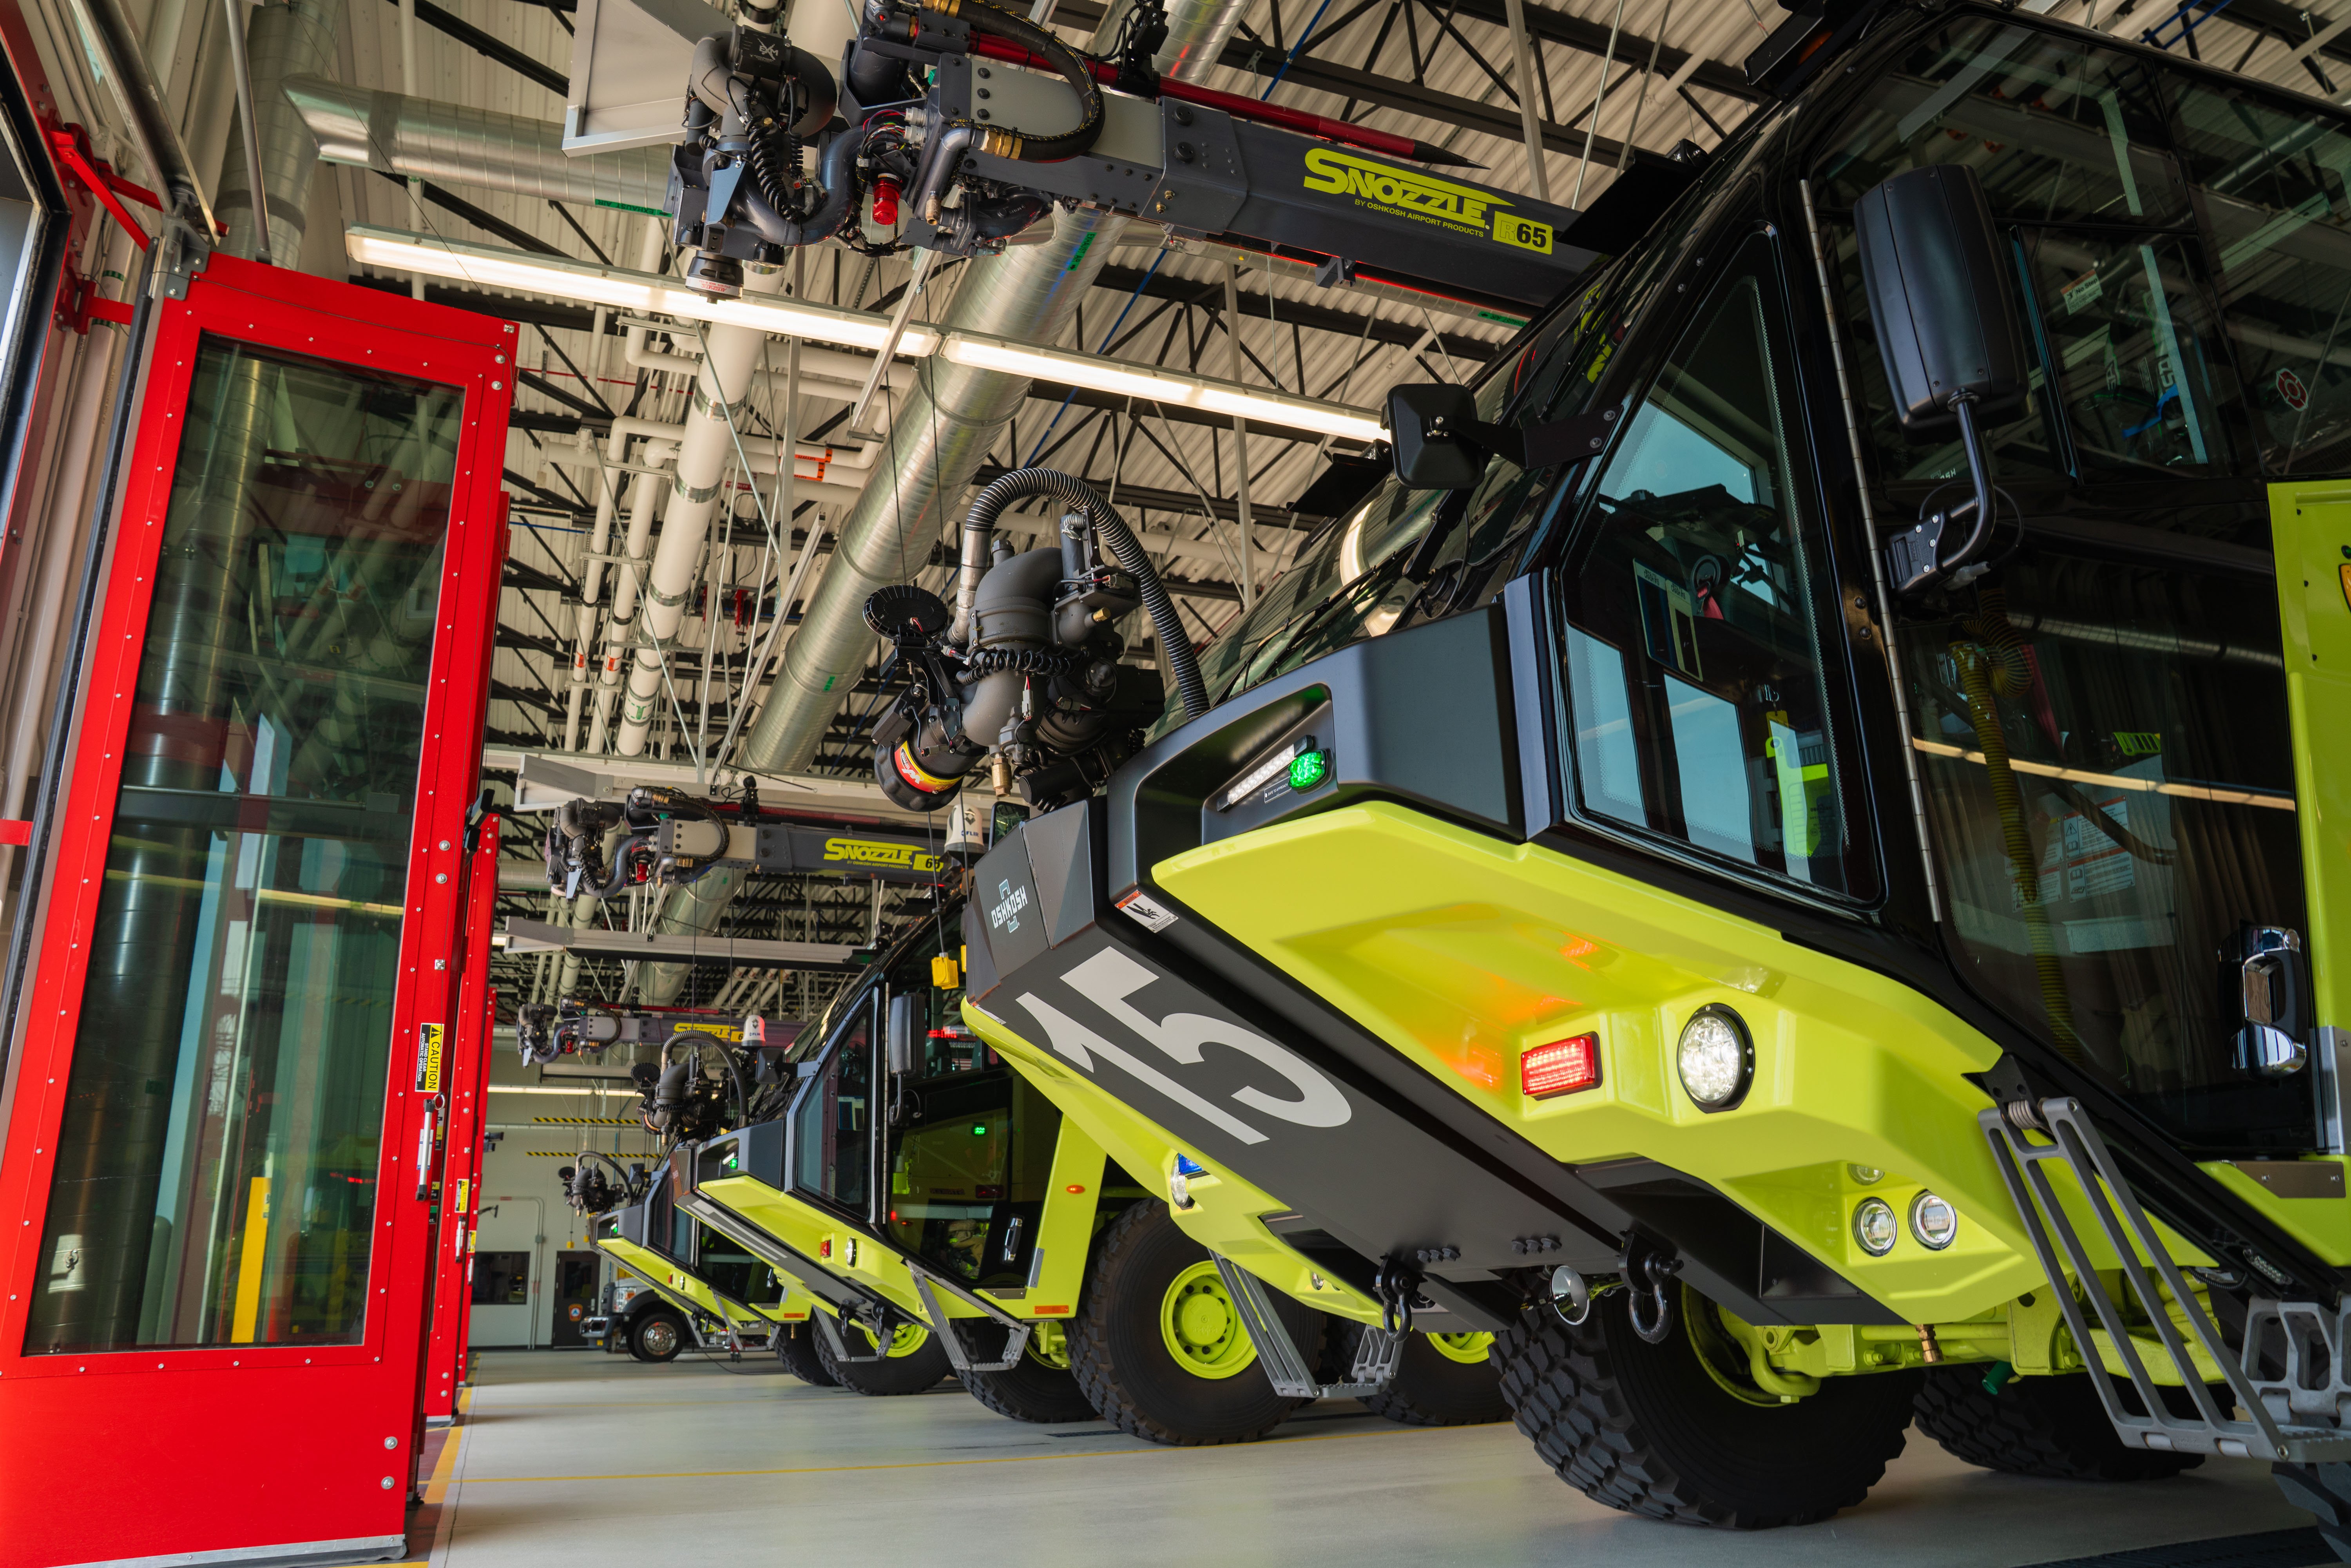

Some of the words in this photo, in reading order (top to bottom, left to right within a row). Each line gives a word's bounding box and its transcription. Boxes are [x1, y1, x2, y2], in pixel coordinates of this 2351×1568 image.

[1304, 148, 1515, 228] SNOZZLE
[616, 203, 654, 215] EXHAUST
[1355, 199, 1366, 207] BY
[1367, 202, 1406, 217] OSHKOSH
[1407, 213, 1442, 226] AIRPORT
[1443, 221, 1484, 237] PRODUCTS
[1074, 255, 1082, 263] AIR
[1077, 233, 1096, 255] EXHAUST
[2076, 286, 2084, 295] No
[2085, 278, 2098, 288] Step
[1277, 783, 1288, 792] APPROACH
[824, 838, 926, 864] SNOZZLE
[991, 885, 1028, 929] OSHKOSH
[1016, 946, 1351, 1145] 15
[428, 1041, 440, 1089] CAUTION
[686, 1199, 788, 1260] 17
